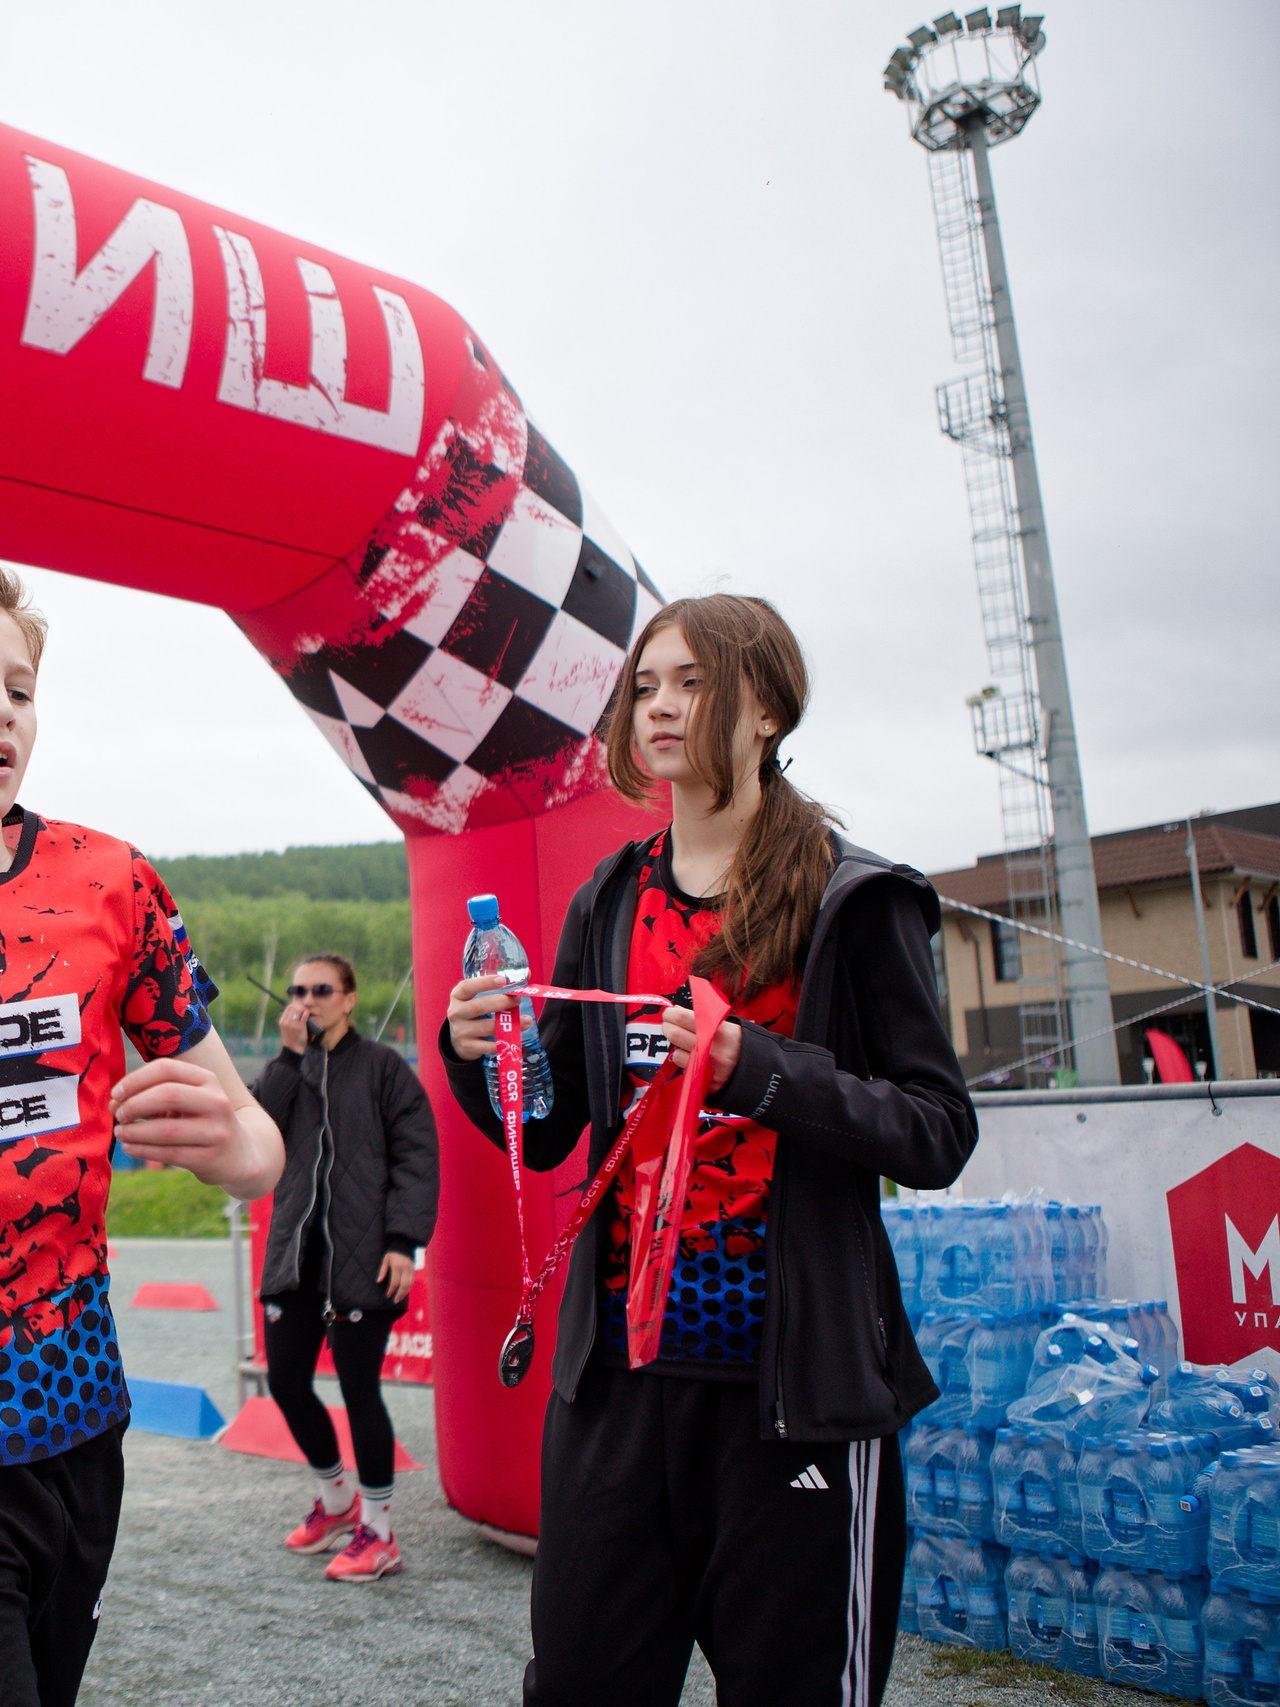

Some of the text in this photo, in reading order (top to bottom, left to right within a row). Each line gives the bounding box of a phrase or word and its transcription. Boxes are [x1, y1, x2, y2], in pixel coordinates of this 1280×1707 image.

[507, 1070, 518, 1102] OCR
[507, 1111, 520, 1190] ФИНИШЕР
[580, 1179, 602, 1208] OCR
